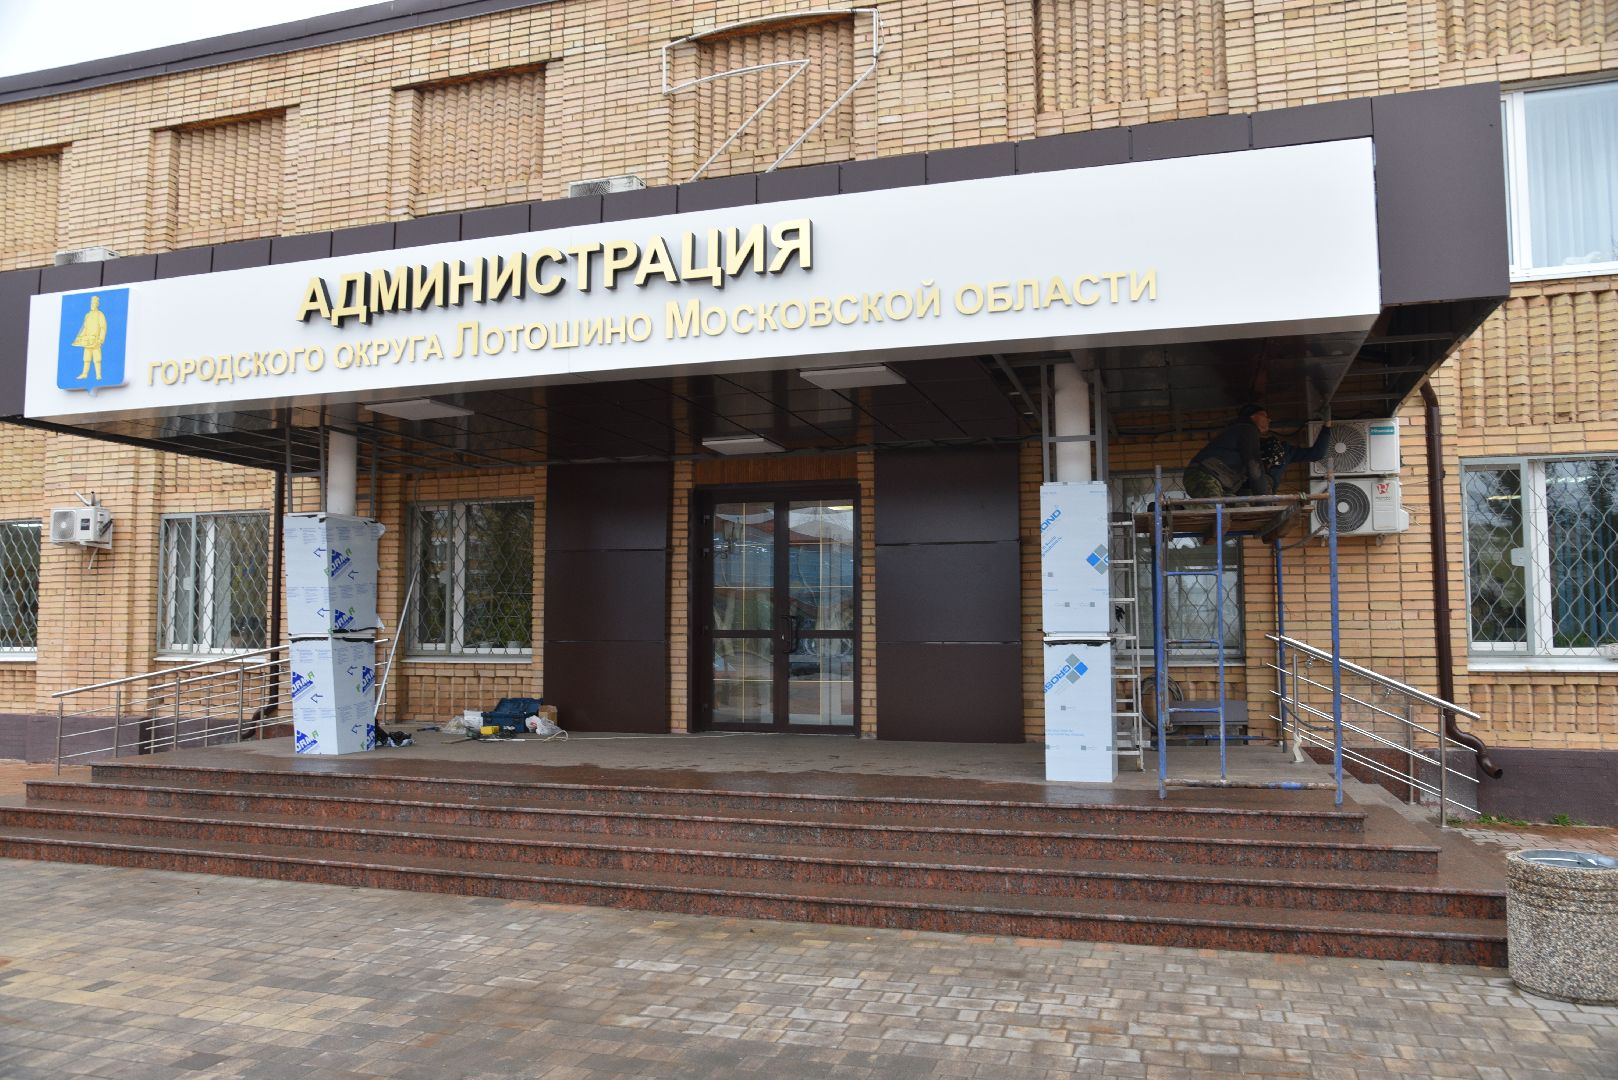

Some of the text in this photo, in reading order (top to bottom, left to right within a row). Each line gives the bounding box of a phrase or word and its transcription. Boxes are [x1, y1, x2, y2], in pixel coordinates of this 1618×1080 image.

[148, 269, 1158, 387] ГОРОДСКОГО ОКРУГА ЛОТОШИНО МОСКОВСКОЙ ОБЛАСТИ
[297, 217, 813, 327] АДМИНИСТРАЦИЯ
